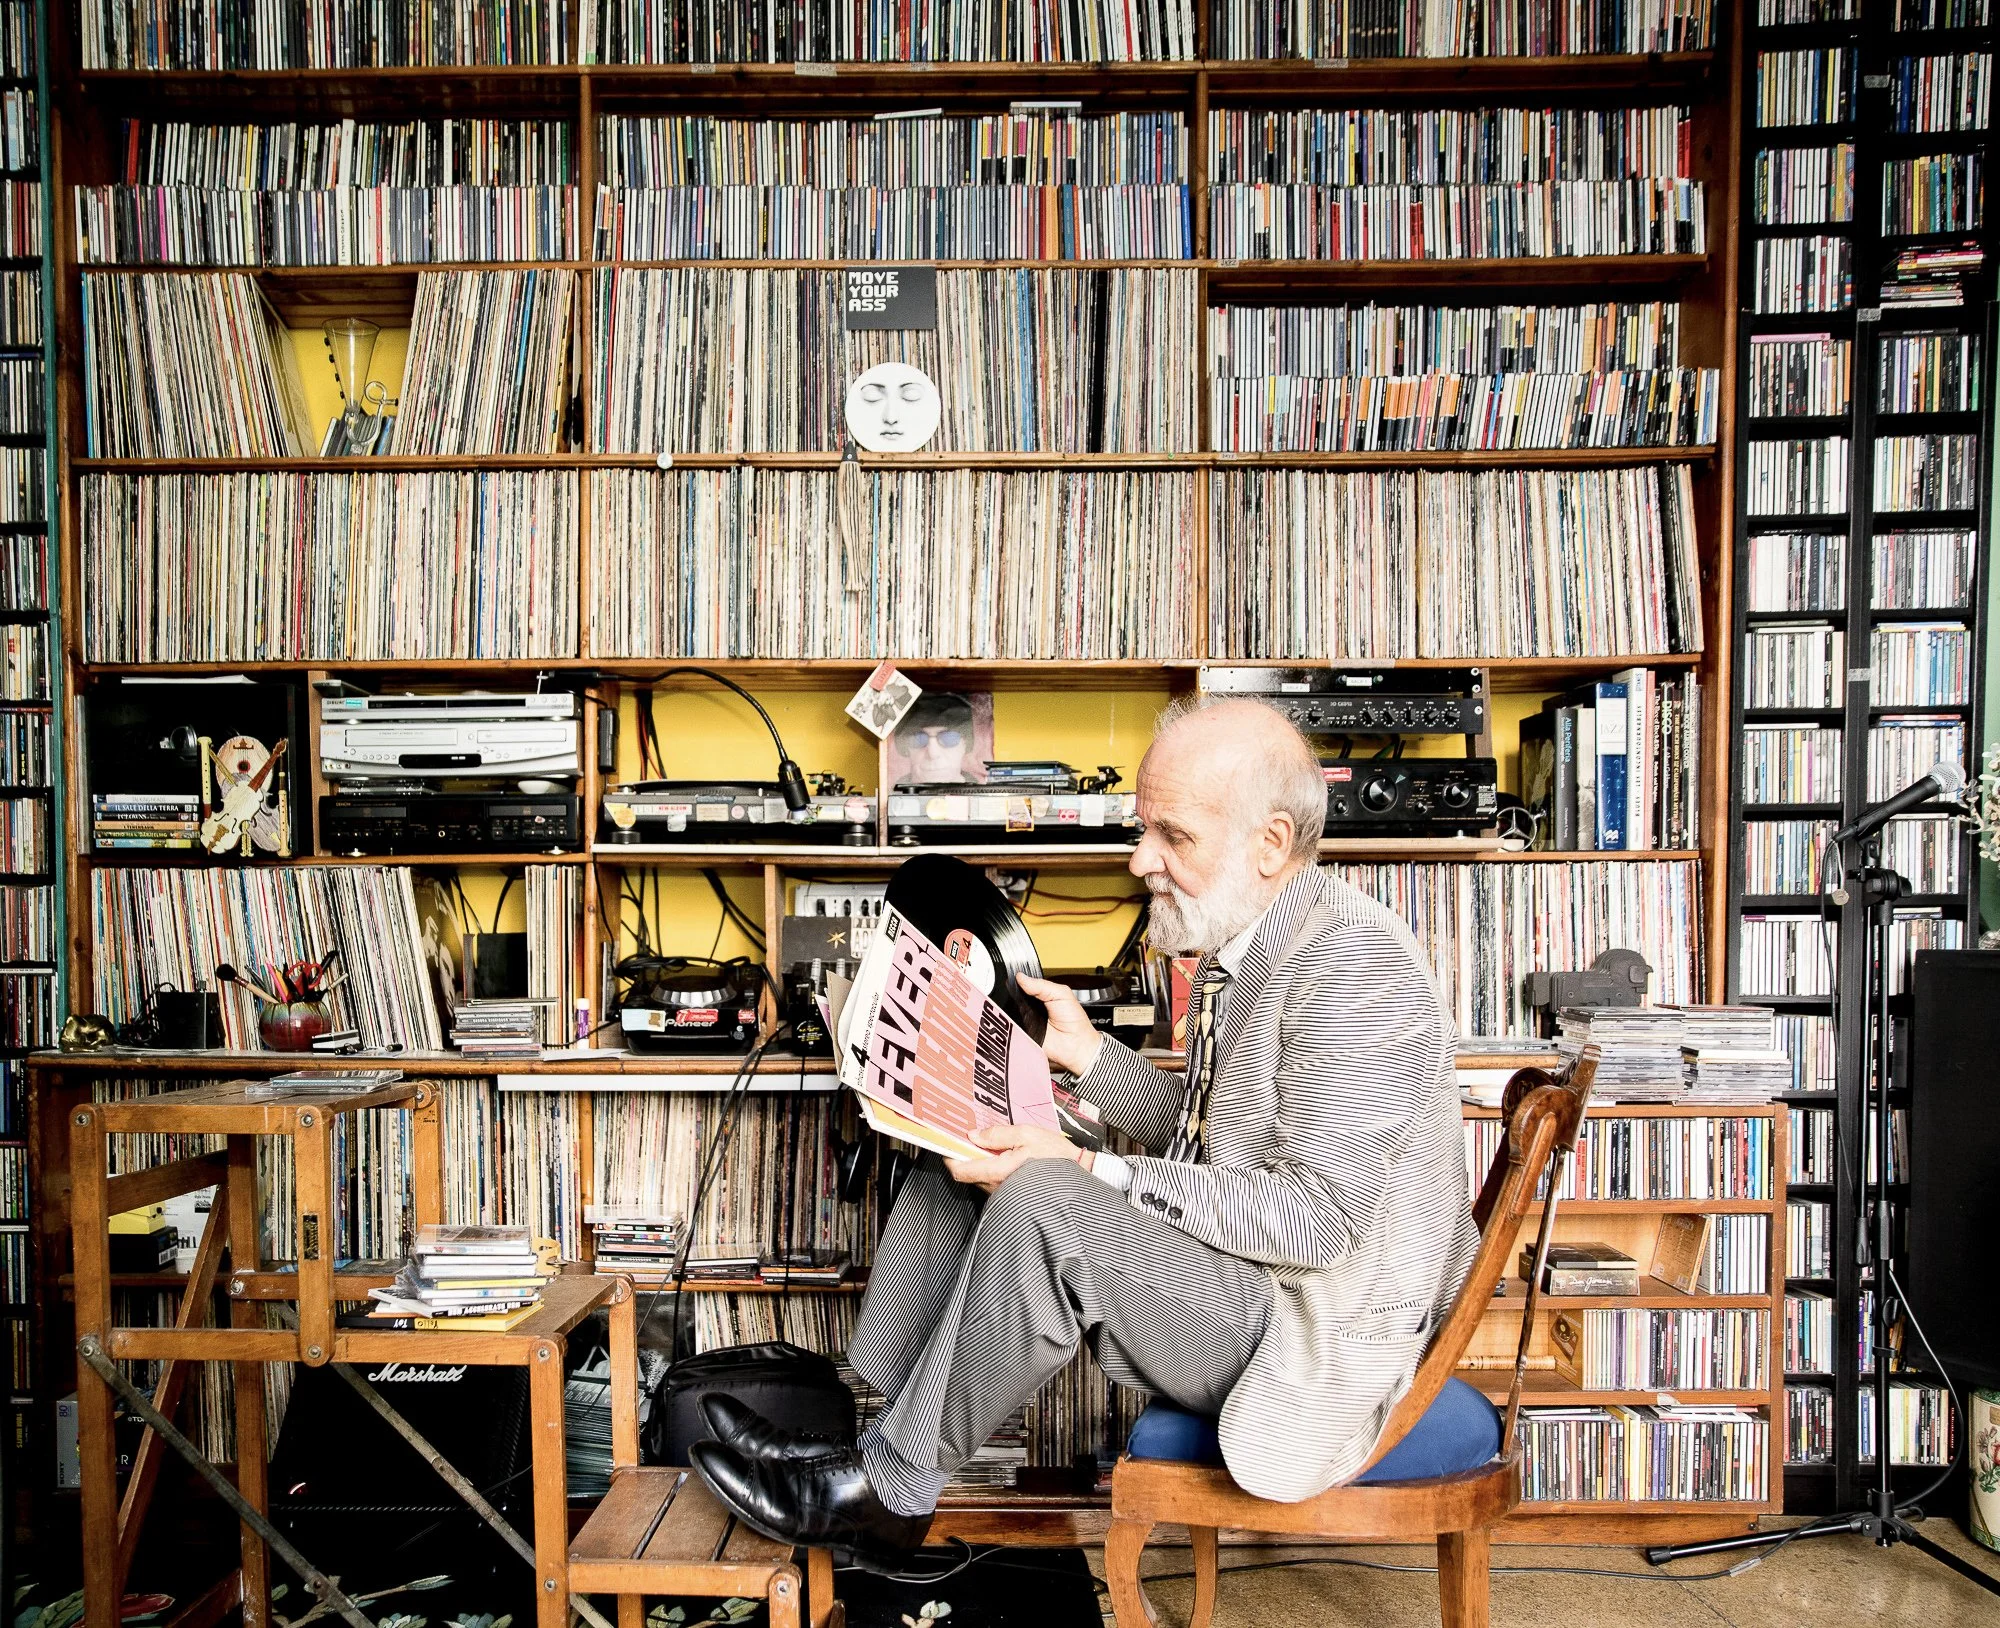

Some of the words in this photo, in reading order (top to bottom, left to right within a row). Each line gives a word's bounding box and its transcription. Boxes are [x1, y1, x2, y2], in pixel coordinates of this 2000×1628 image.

[848, 271, 899, 285] MOVE
[848, 285, 899, 298] YOUR
[848, 298, 887, 312] ASS
[1563, 717, 1573, 731] Alla
[1661, 700, 1673, 734] DISCO
[1562, 732, 1573, 763] Periferia
[115, 803, 121, 811] IL
[122, 803, 137, 812] SALE
[138, 803, 158, 812] DELLA
[159, 803, 179, 812] TERRA
[1634, 796, 1642, 818] BLUES
[887, 915, 900, 940] DECCA
[962, 937, 972, 950] 4
[664, 1018, 717, 1028] Pioneer
[850, 1042, 871, 1069] 4
[862, 1028, 871, 1050] stereo
[867, 992, 880, 1029] spectacular
[914, 980, 979, 1103] HEATH
[974, 998, 1011, 1074] MUSIC
[973, 1058, 1009, 1107] HIS
[973, 1091, 1009, 1117] &
[367, 1362, 468, 1382] Marshall
[58, 1404, 69, 1418] 80
